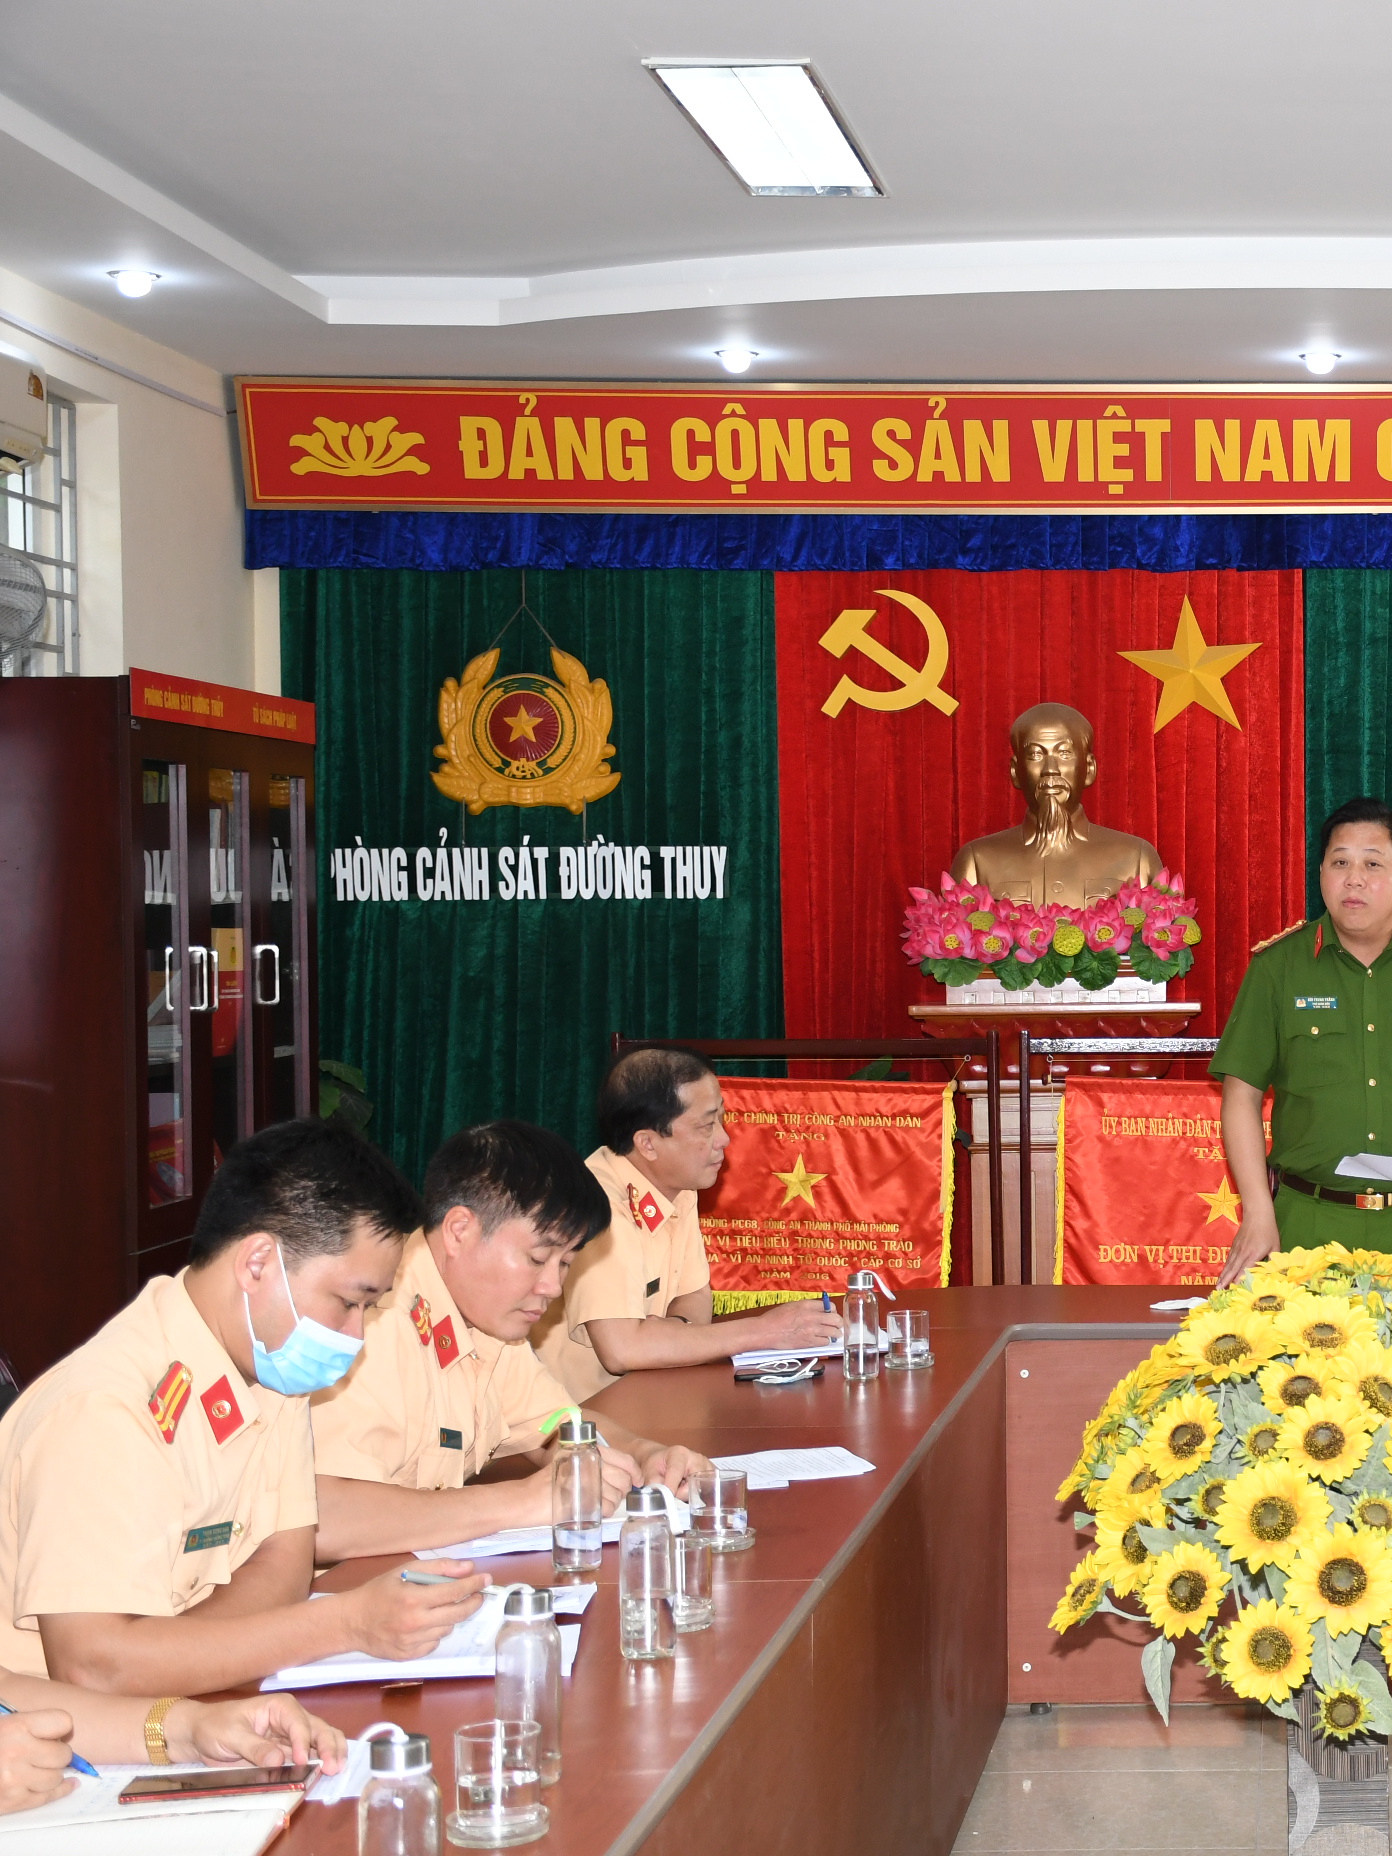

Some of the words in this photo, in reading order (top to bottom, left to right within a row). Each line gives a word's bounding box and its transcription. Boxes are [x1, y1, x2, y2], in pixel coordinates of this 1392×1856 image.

[458, 393, 649, 482] ĐẢNG
[670, 403, 851, 494] CỘNG
[872, 396, 1011, 482] SẢN
[1031, 405, 1171, 494] VIỆT
[1194, 418, 1351, 483] NAM
[331, 836, 409, 901] HÒNG
[415, 827, 490, 901] CẢNH
[498, 835, 549, 900] SÁT
[559, 834, 652, 900] ĐƯỜNG
[660, 845, 728, 900] THUY
[723, 1111, 739, 1124] ỤC
[744, 1110, 778, 1124] CHÍNH
[781, 1113, 800, 1127] TRỊ
[805, 1112, 834, 1126] CÔNG
[839, 1115, 855, 1126] AN
[859, 1113, 891, 1127] NHÂN
[896, 1114, 921, 1127] DÂN
[1101, 1107, 1118, 1135] ỦY
[1121, 1117, 1146, 1136] BAN
[1148, 1112, 1183, 1137] NHÂN
[1186, 1113, 1211, 1138] DÂN
[775, 1129, 826, 1142] TẶNG
[789, 1220, 801, 1230] AN
[794, 1236, 834, 1250] TRONG
[839, 1239, 877, 1251] PHONG
[745, 1254, 761, 1264] AN
[765, 1255, 793, 1265] NINH
[1098, 1242, 1139, 1263] ĐƠN
[1143, 1245, 1165, 1269] VỊ
[1168, 1245, 1202, 1264] THI
